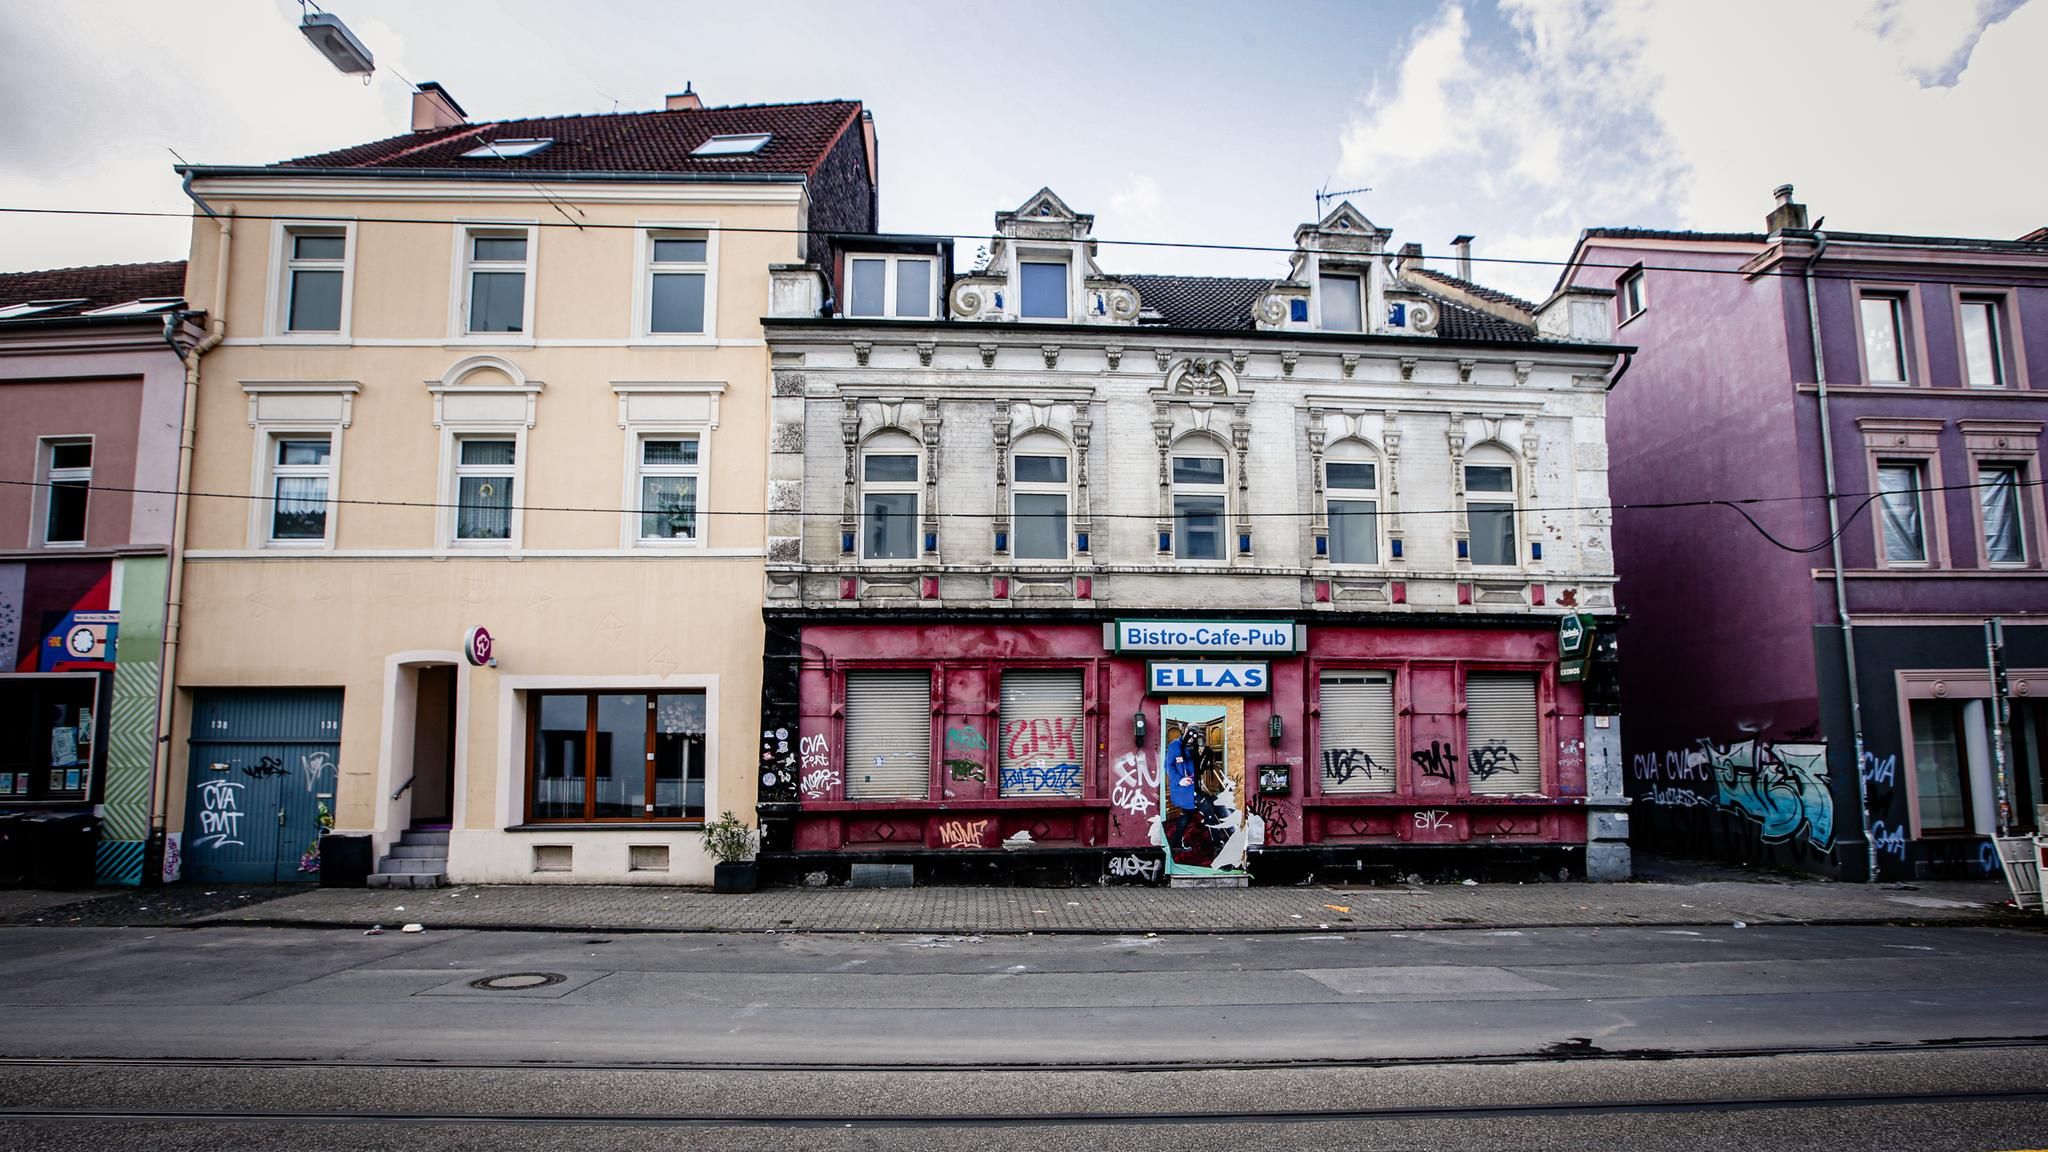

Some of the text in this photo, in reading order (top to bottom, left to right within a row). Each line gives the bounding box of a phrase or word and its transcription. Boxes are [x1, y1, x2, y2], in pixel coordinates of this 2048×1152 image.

[1127, 628, 1286, 646] Bistro-Cafe-Pub
[1156, 669, 1263, 687] ELLAS
[211, 720, 228, 730] 138
[800, 733, 829, 755] CVA
[1633, 751, 1660, 781] CVA
[1862, 751, 1896, 787] CVA
[203, 784, 237, 810] CVA
[200, 811, 245, 837] PMT
